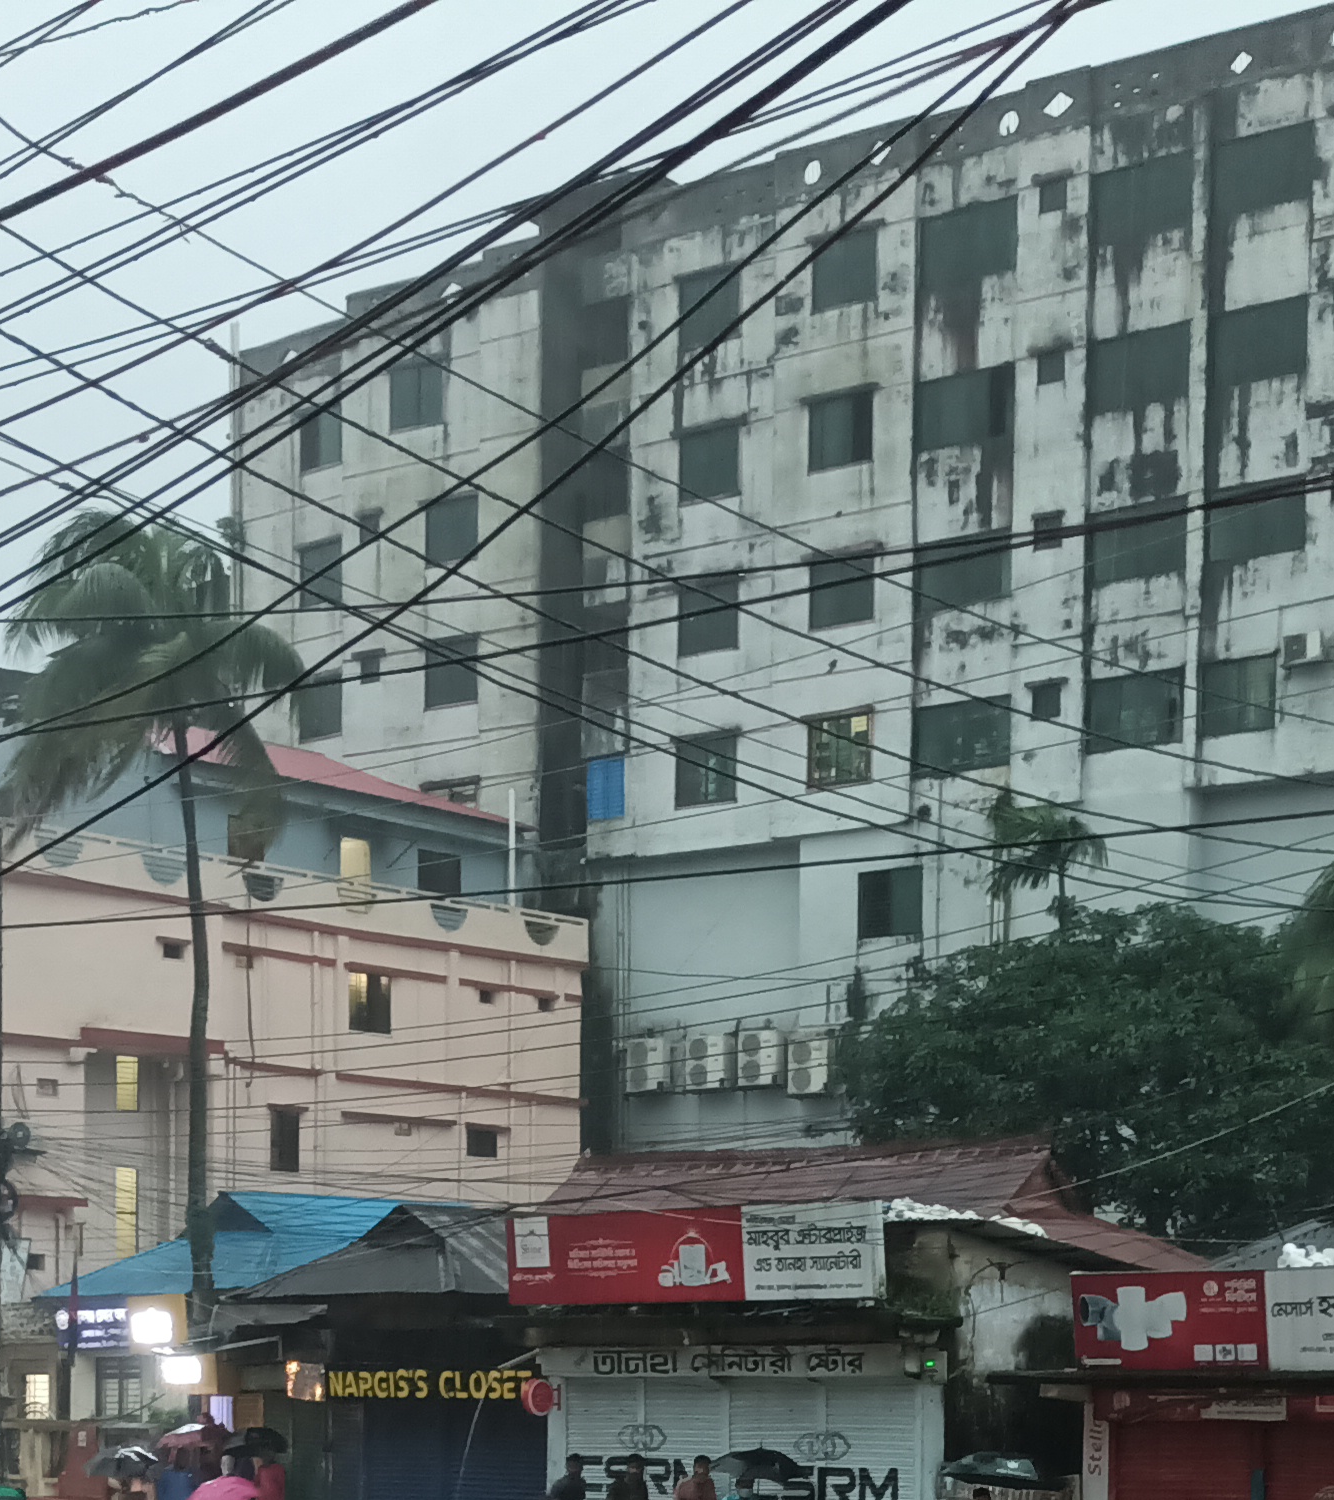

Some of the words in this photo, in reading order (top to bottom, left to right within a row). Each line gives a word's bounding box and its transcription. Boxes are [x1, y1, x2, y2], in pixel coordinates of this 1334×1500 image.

[746, 1228, 791, 1251] মাহবুব
[774, 1257, 807, 1272] তানহা
[1271, 1298, 1315, 1318] মেসার্স
[593, 1350, 677, 1375] তানহা
[329, 1369, 428, 1398] NARGIS'S
[439, 1369, 532, 1399] CLOSET
